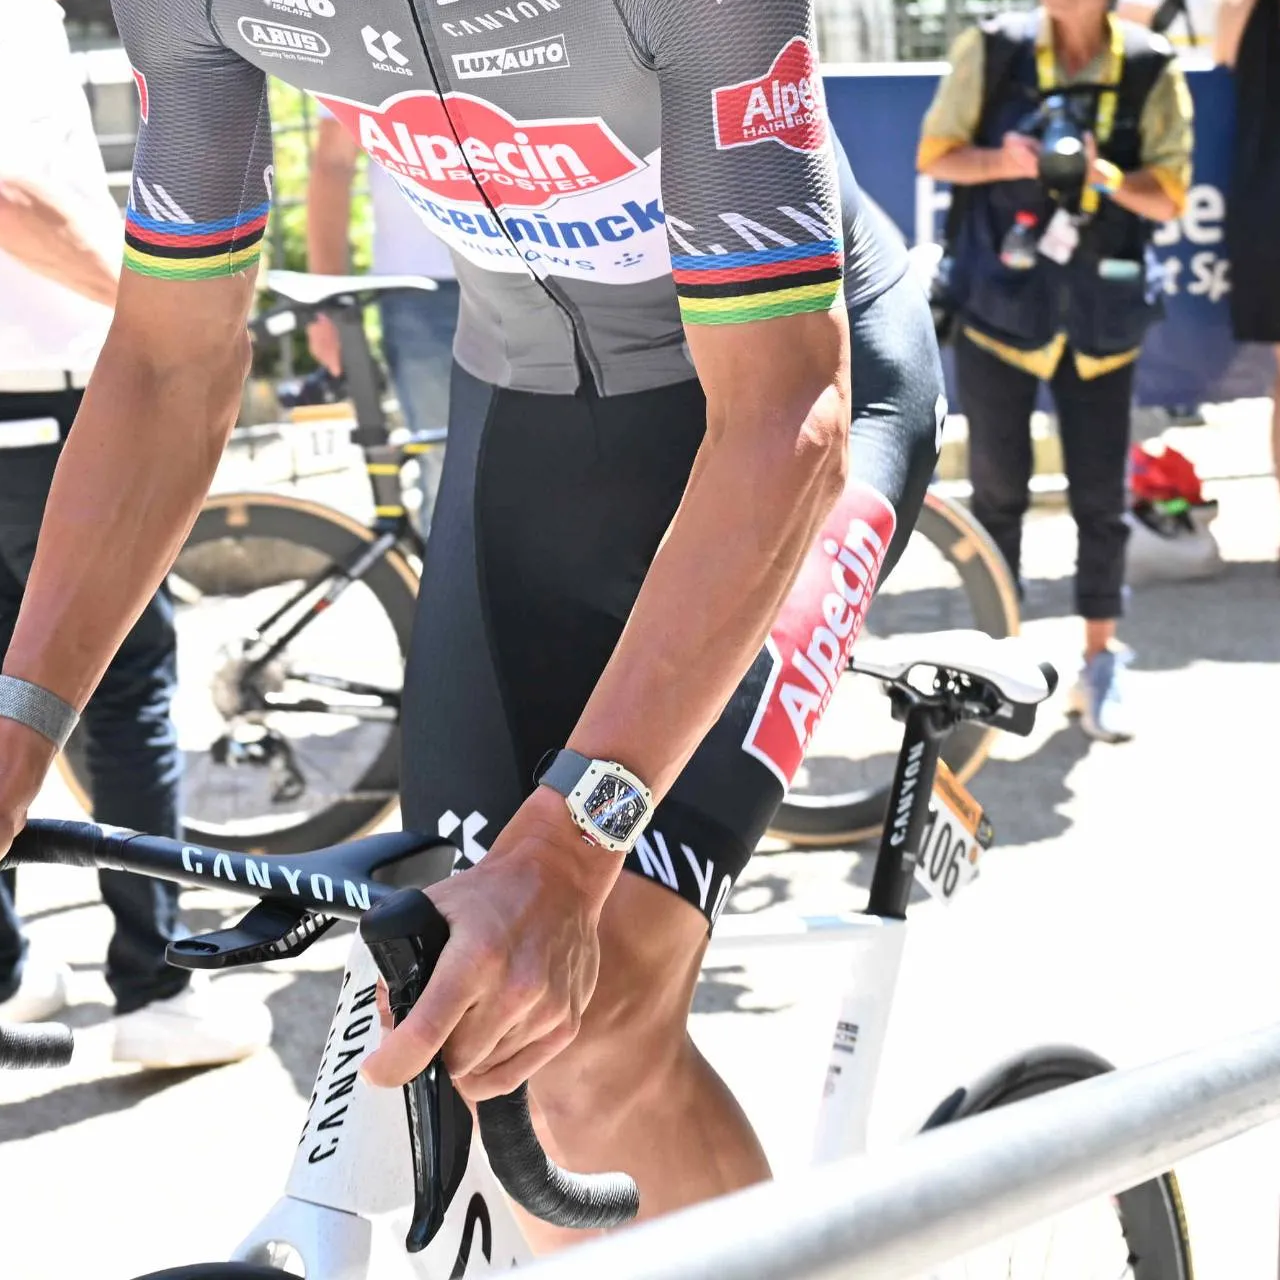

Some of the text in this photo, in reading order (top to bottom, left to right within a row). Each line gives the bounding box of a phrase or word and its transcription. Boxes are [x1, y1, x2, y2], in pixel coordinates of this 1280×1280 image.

[251, 24, 320, 52] ABUS
[272, 3, 313, 19] ISOLATIE
[741, 76, 817, 129] Alpe
[742, 121, 787, 139] HAIR
[358, 113, 591, 182] Alpecin
[448, 168, 601, 194] BOOSTER
[777, 517, 885, 749] Alpecin
[889, 740, 925, 847] CANYON
[181, 846, 372, 911] CANYON
[308, 982, 378, 1165] CANYON
